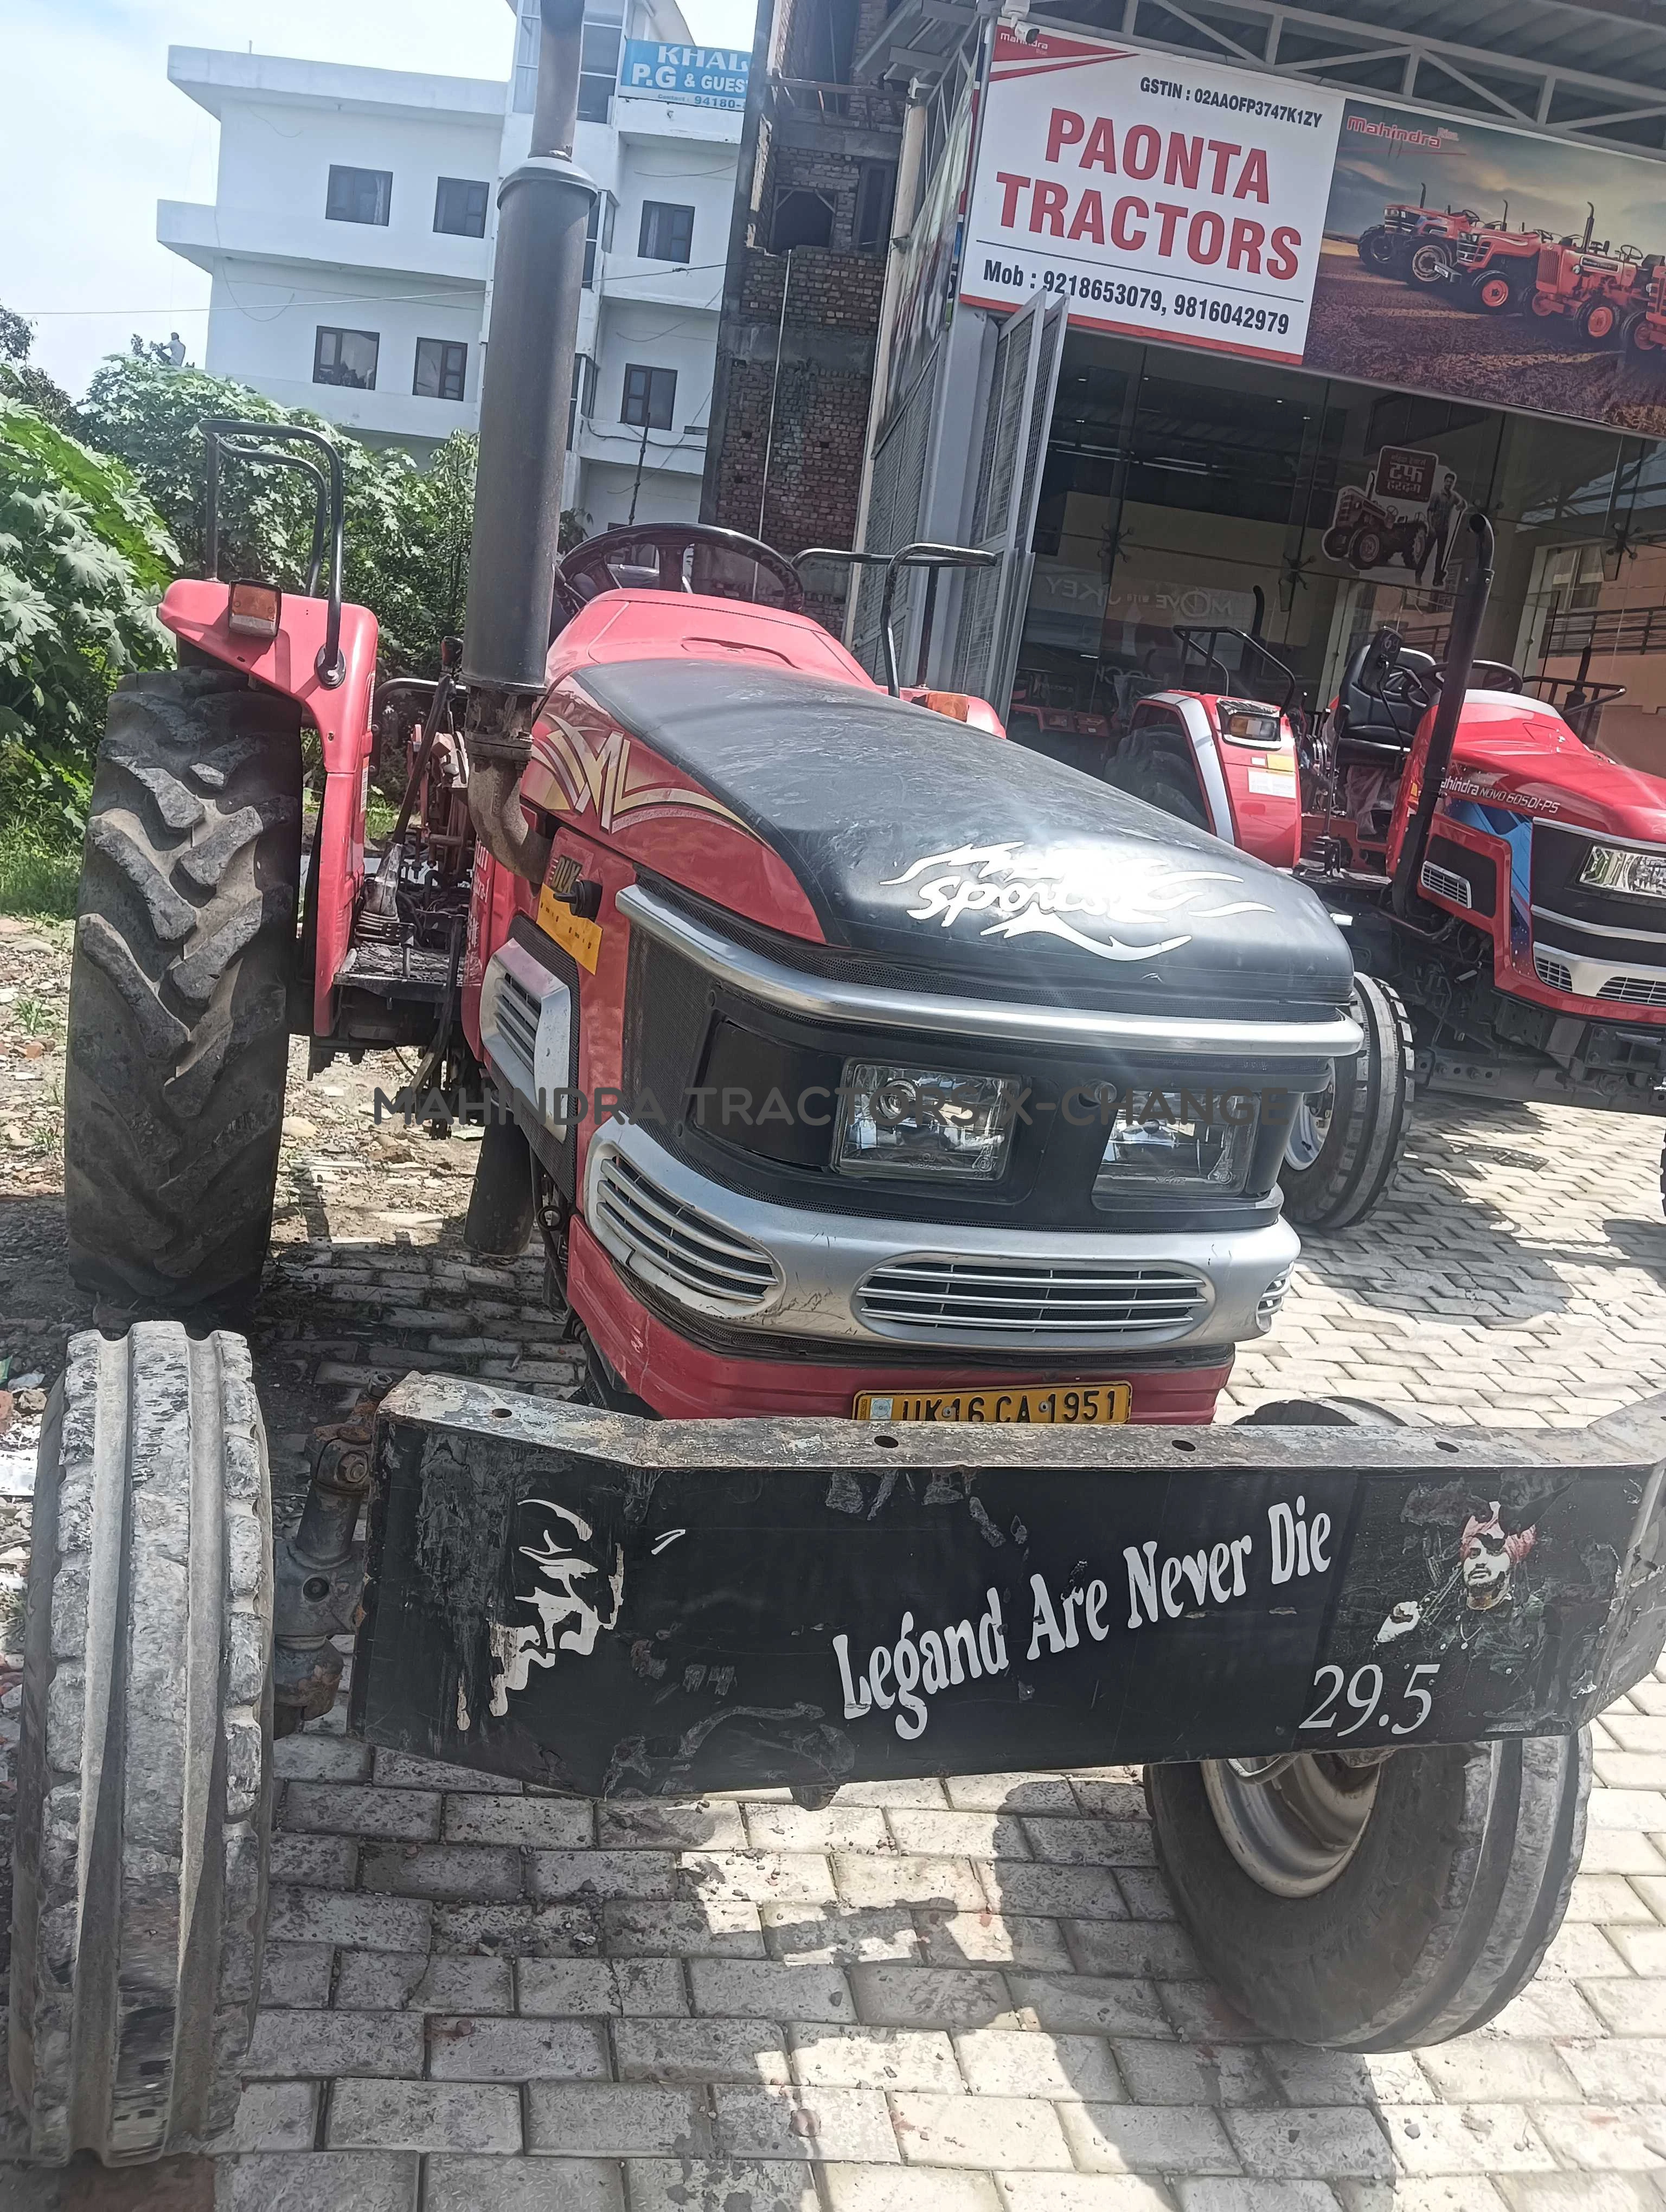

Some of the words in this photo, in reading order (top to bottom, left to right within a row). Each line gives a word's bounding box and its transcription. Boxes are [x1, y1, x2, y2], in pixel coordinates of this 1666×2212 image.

[631, 62, 676, 88] P.G
[684, 72, 696, 88] &
[701, 75, 748, 93] GUES
[694, 95, 745, 108] 94180-
[1140, 76, 1183, 99] GSTIN
[1045, 107, 1270, 204] PAONTA
[996, 171, 1302, 280] TRACTORS
[983, 259, 1024, 288] Mob
[1042, 271, 1167, 316] 9218653079,
[1174, 293, 1290, 335] 9816042979
[1440, 775, 1479, 796] ahindra
[1479, 787, 1507, 802] NOVO
[902, 1398, 942, 1421] UK
[950, 1394, 985, 1422] 16
[996, 1395, 1031, 1423] CA
[1046, 1390, 1116, 1424] 1951
[1027, 1571, 1110, 1661] Are
[1123, 1534, 1252, 1629] Never
[1268, 1495, 1331, 1586] Die
[1299, 1664, 1440, 1737] 29.5
